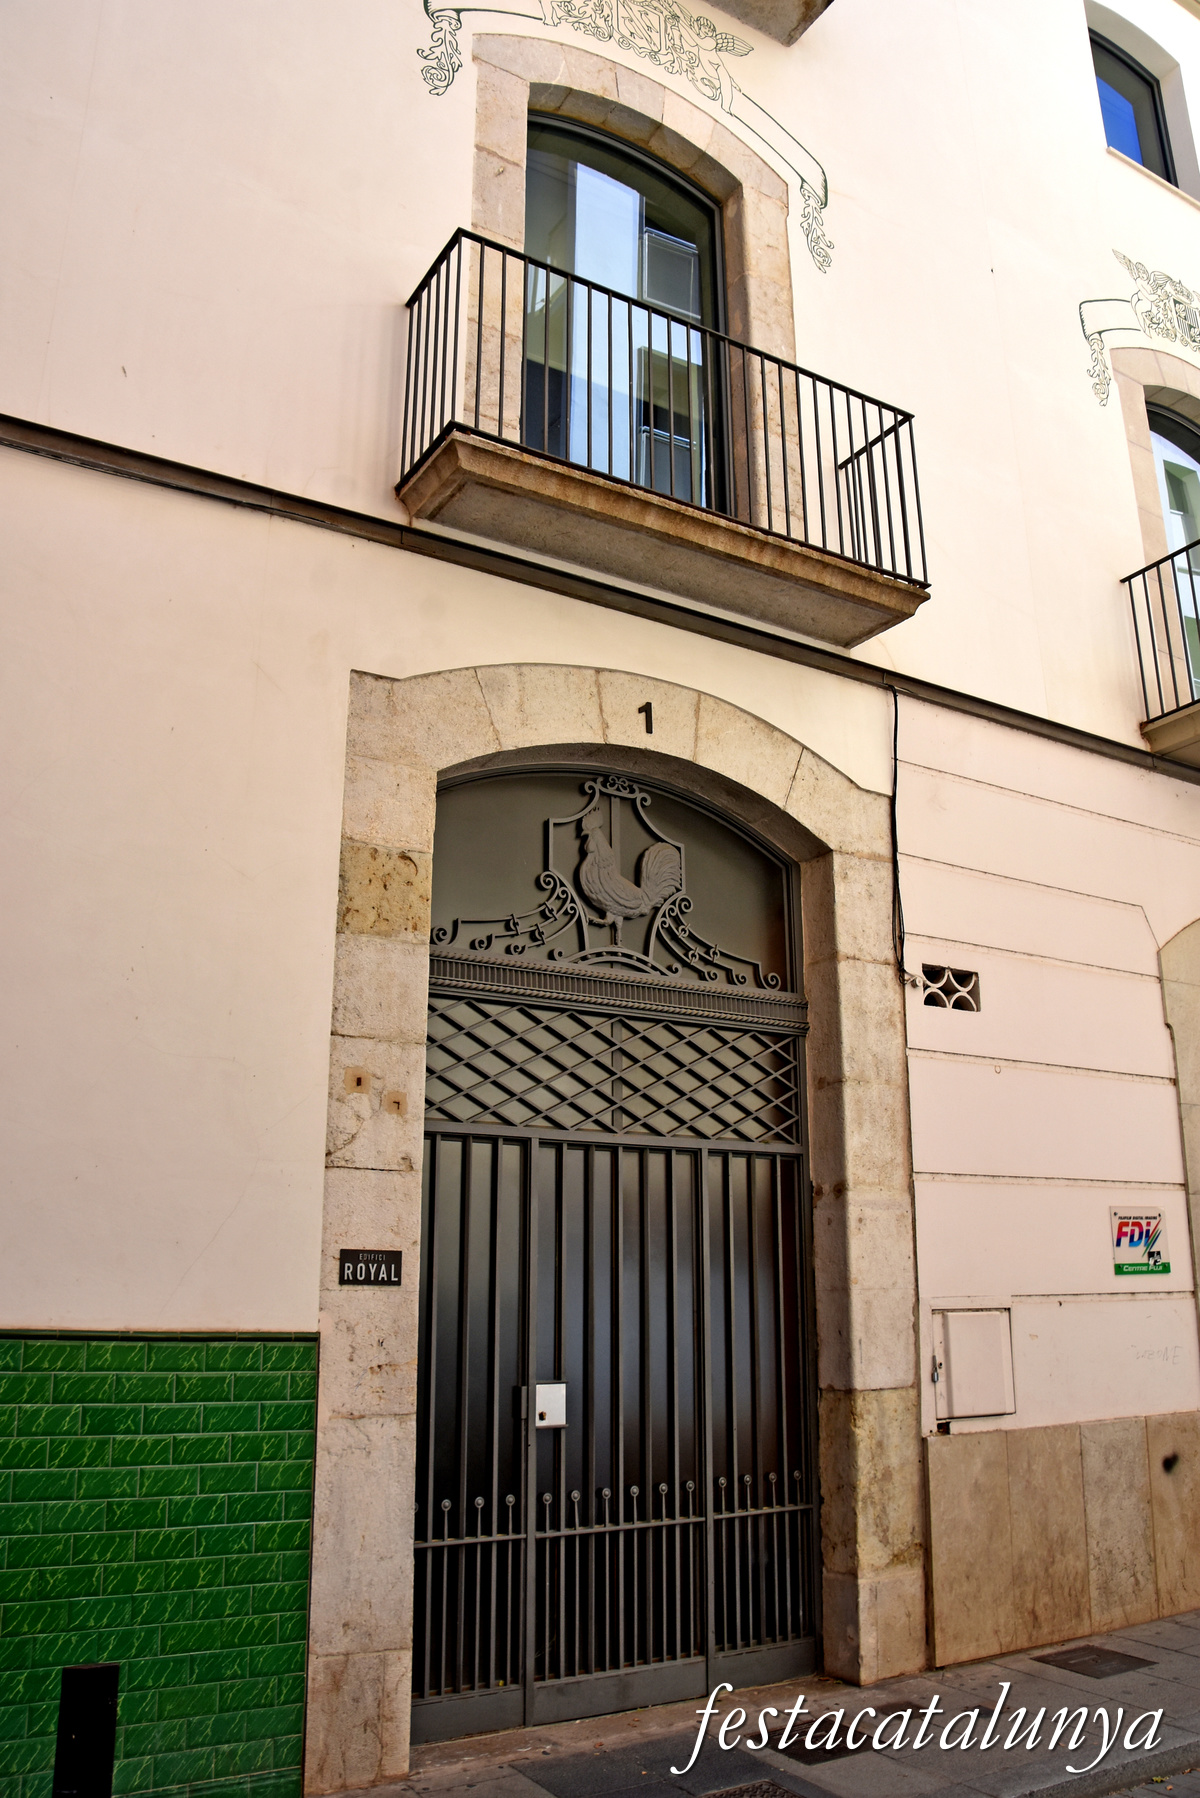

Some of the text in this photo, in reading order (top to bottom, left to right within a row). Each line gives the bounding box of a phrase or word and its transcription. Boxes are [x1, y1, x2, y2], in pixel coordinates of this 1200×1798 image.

[638, 701, 654, 734] 1
[359, 1253, 386, 1261] EDIFICI
[344, 1263, 399, 1281] ROYAL
